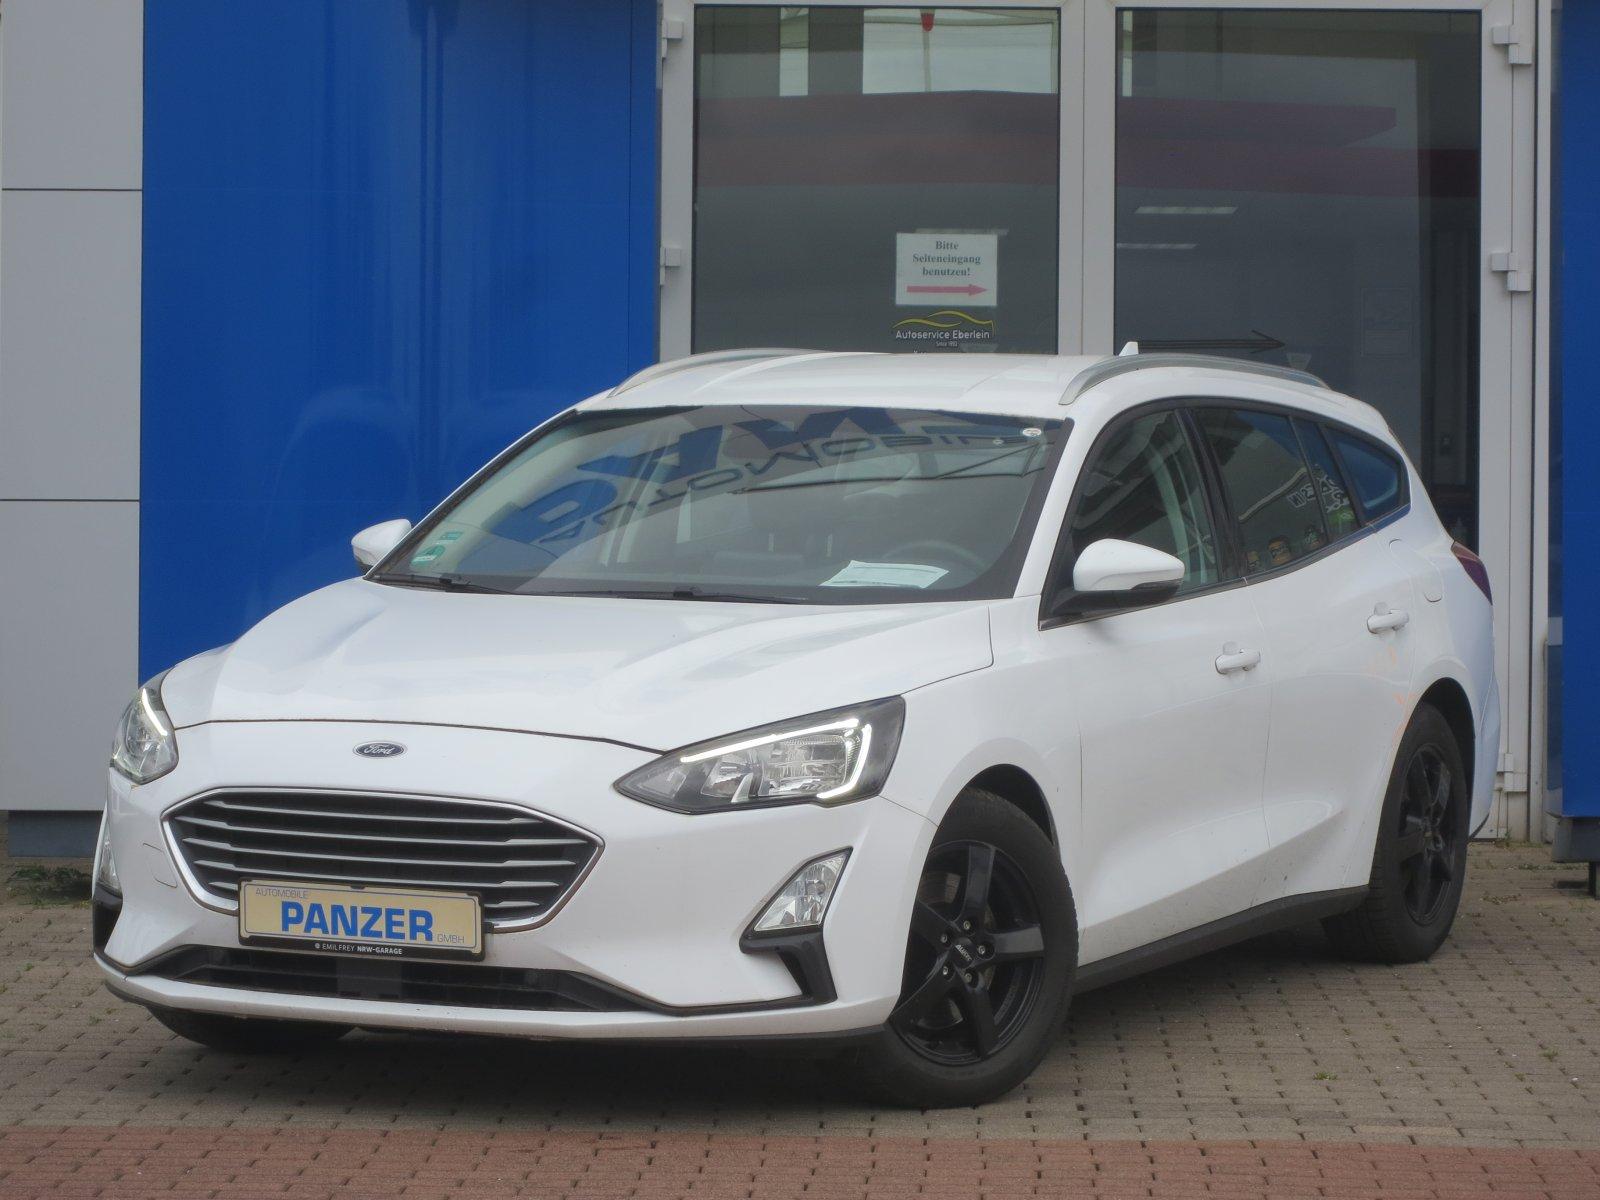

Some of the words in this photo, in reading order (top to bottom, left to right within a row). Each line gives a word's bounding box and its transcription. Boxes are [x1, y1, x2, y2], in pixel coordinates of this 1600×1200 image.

[935, 240, 959, 250] Bitte
[912, 253, 981, 265] Seiteneingang
[922, 267, 971, 276] benutzen!
[895, 329, 951, 339] Autoservice
[952, 329, 990, 339] Eberlein
[363, 744, 396, 755] Ford
[255, 887, 309, 899] AUTOMOBILE
[281, 900, 434, 942] PANZER
[437, 933, 465, 944] GMBH
[356, 945, 403, 954] NRW-GARAGE
